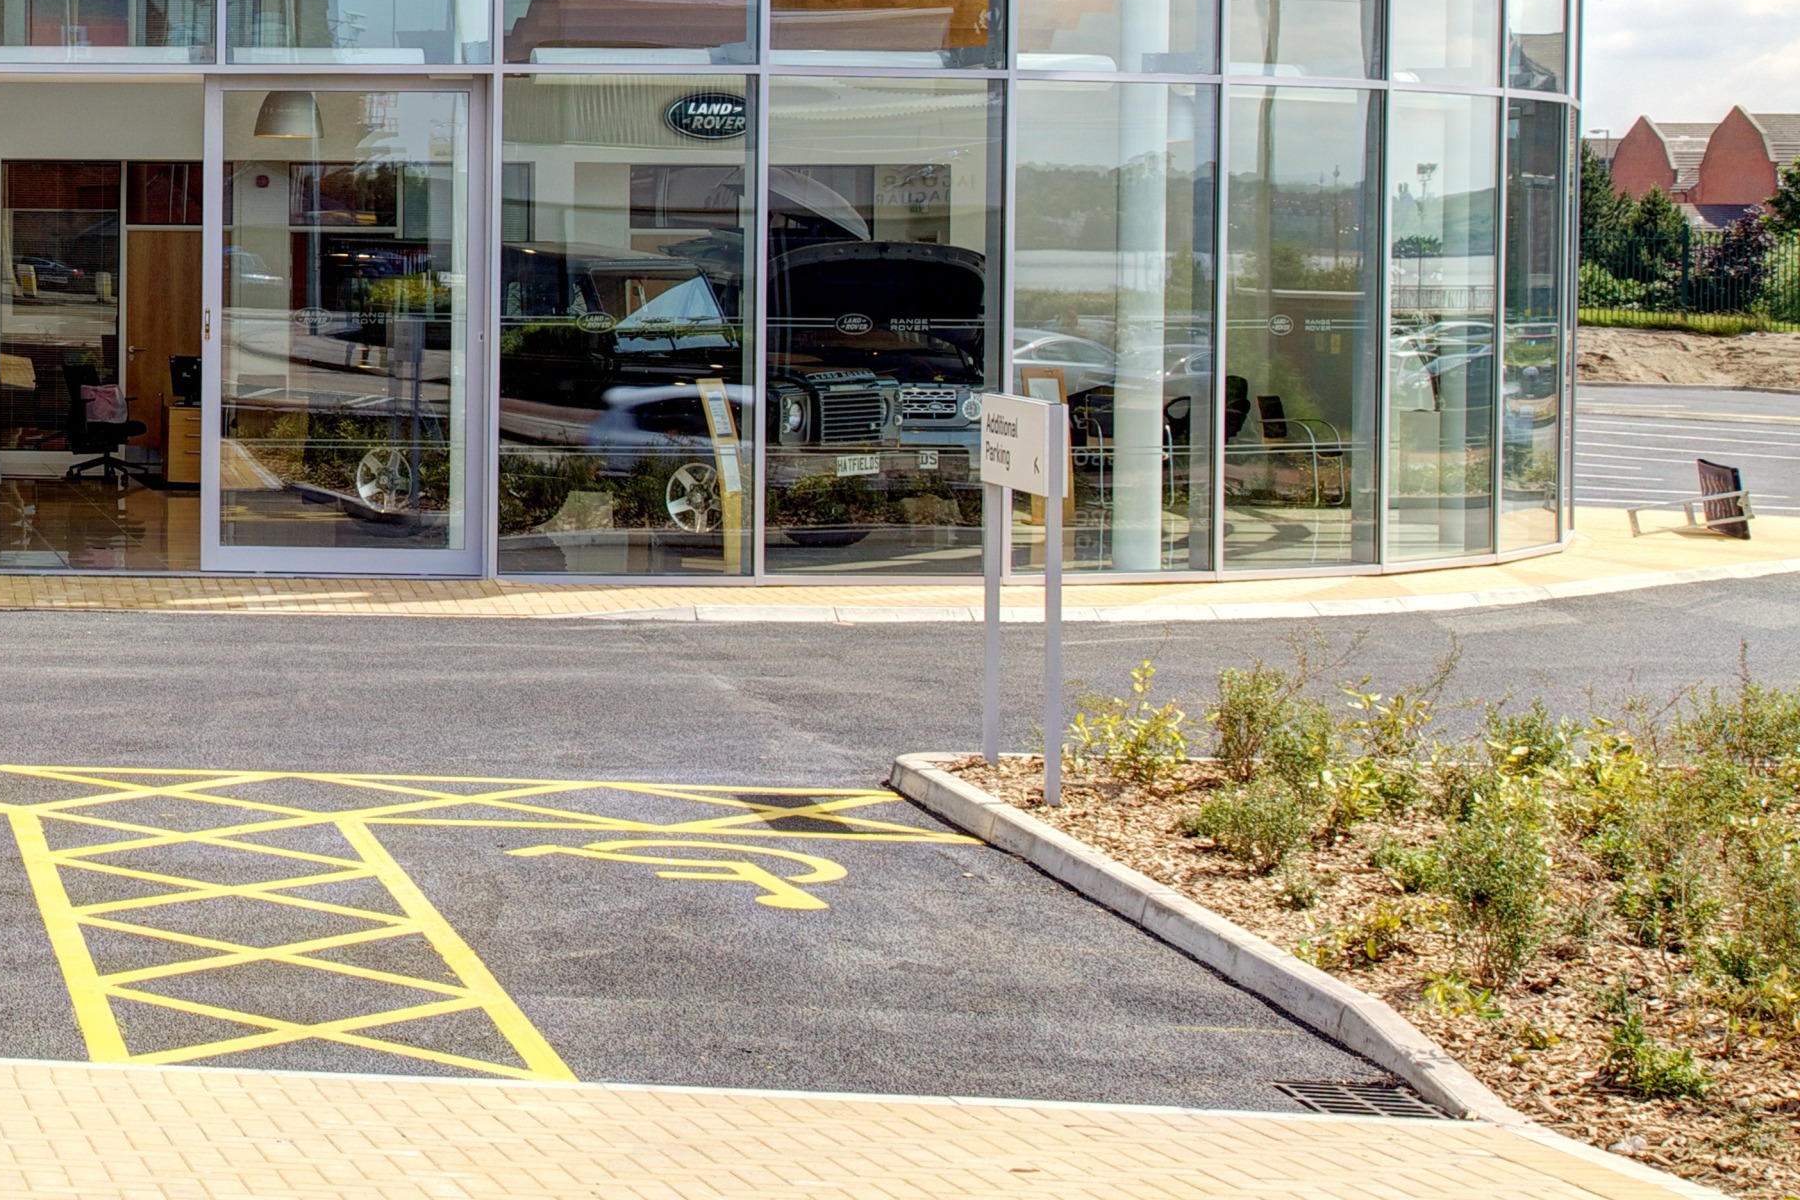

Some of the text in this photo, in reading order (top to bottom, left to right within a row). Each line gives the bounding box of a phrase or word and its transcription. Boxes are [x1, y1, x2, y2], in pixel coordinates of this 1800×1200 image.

[687, 102, 733, 115] LAND
[691, 115, 746, 129] ROVER
[845, 323, 869, 331] ROVER
[985, 412, 1018, 439] Additional
[985, 440, 1011, 471] Parking
[836, 456, 880, 473] HATFIELDS
